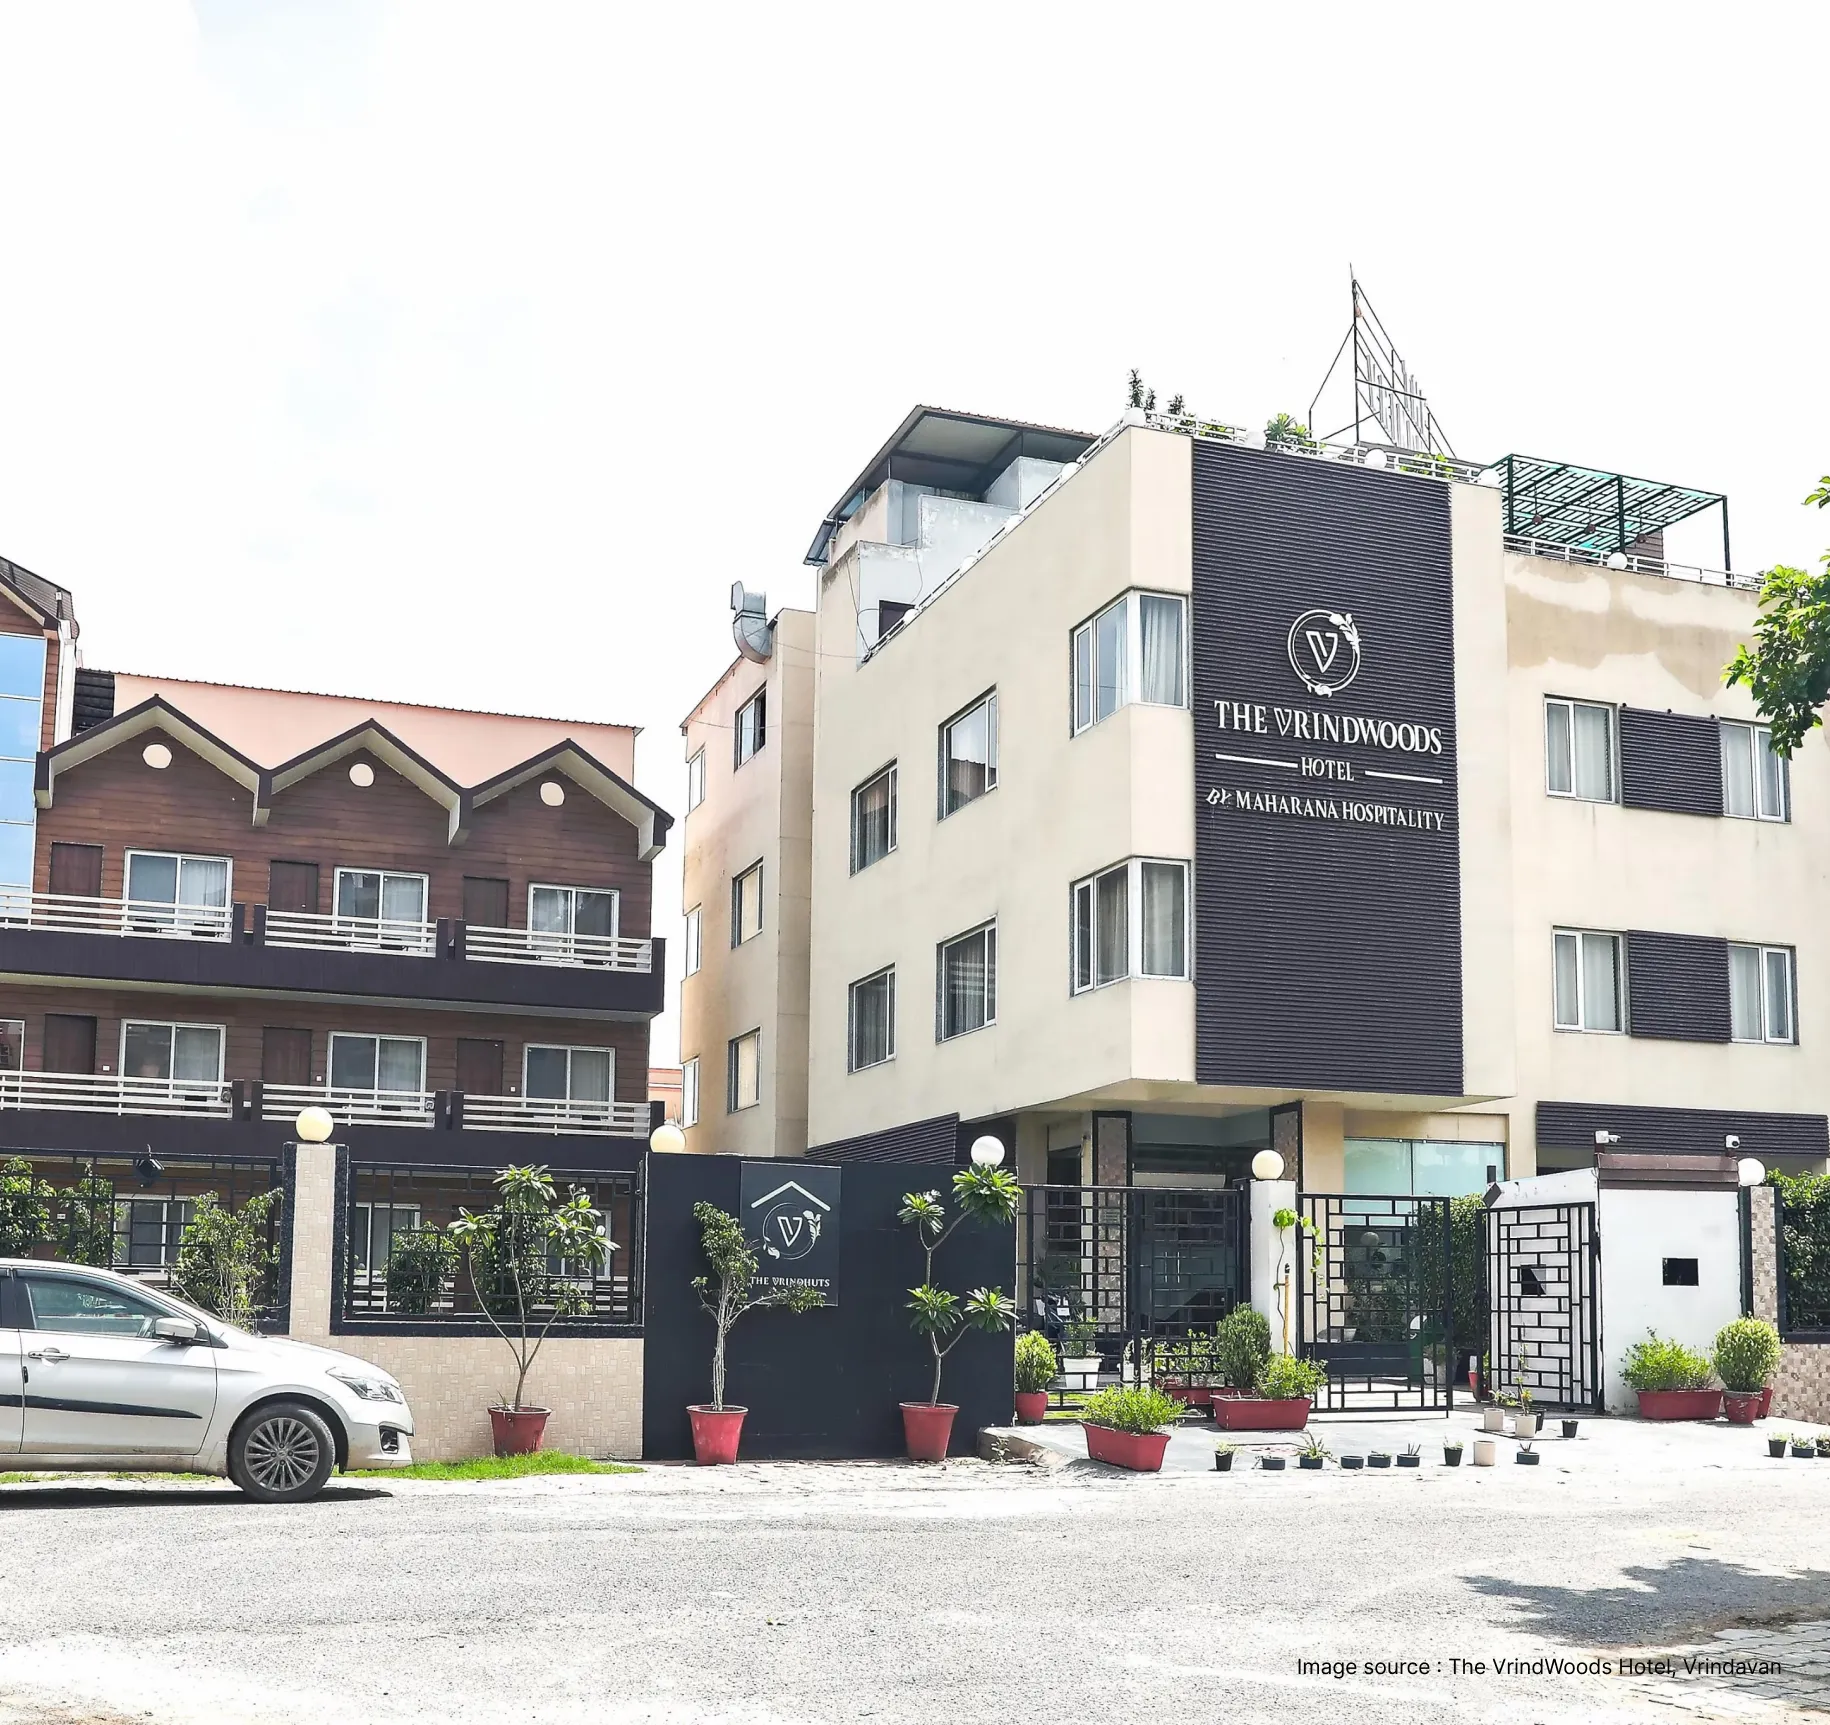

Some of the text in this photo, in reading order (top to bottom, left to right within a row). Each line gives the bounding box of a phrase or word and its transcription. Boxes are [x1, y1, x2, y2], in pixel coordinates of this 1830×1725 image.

[1214, 700, 1442, 755] THE VRINDWOODS
[1301, 757, 1355, 782] HOTEL
[1206, 788, 1444, 831] BY MAHARANA HOSPITALITY
[750, 1276, 769, 1286] THE
